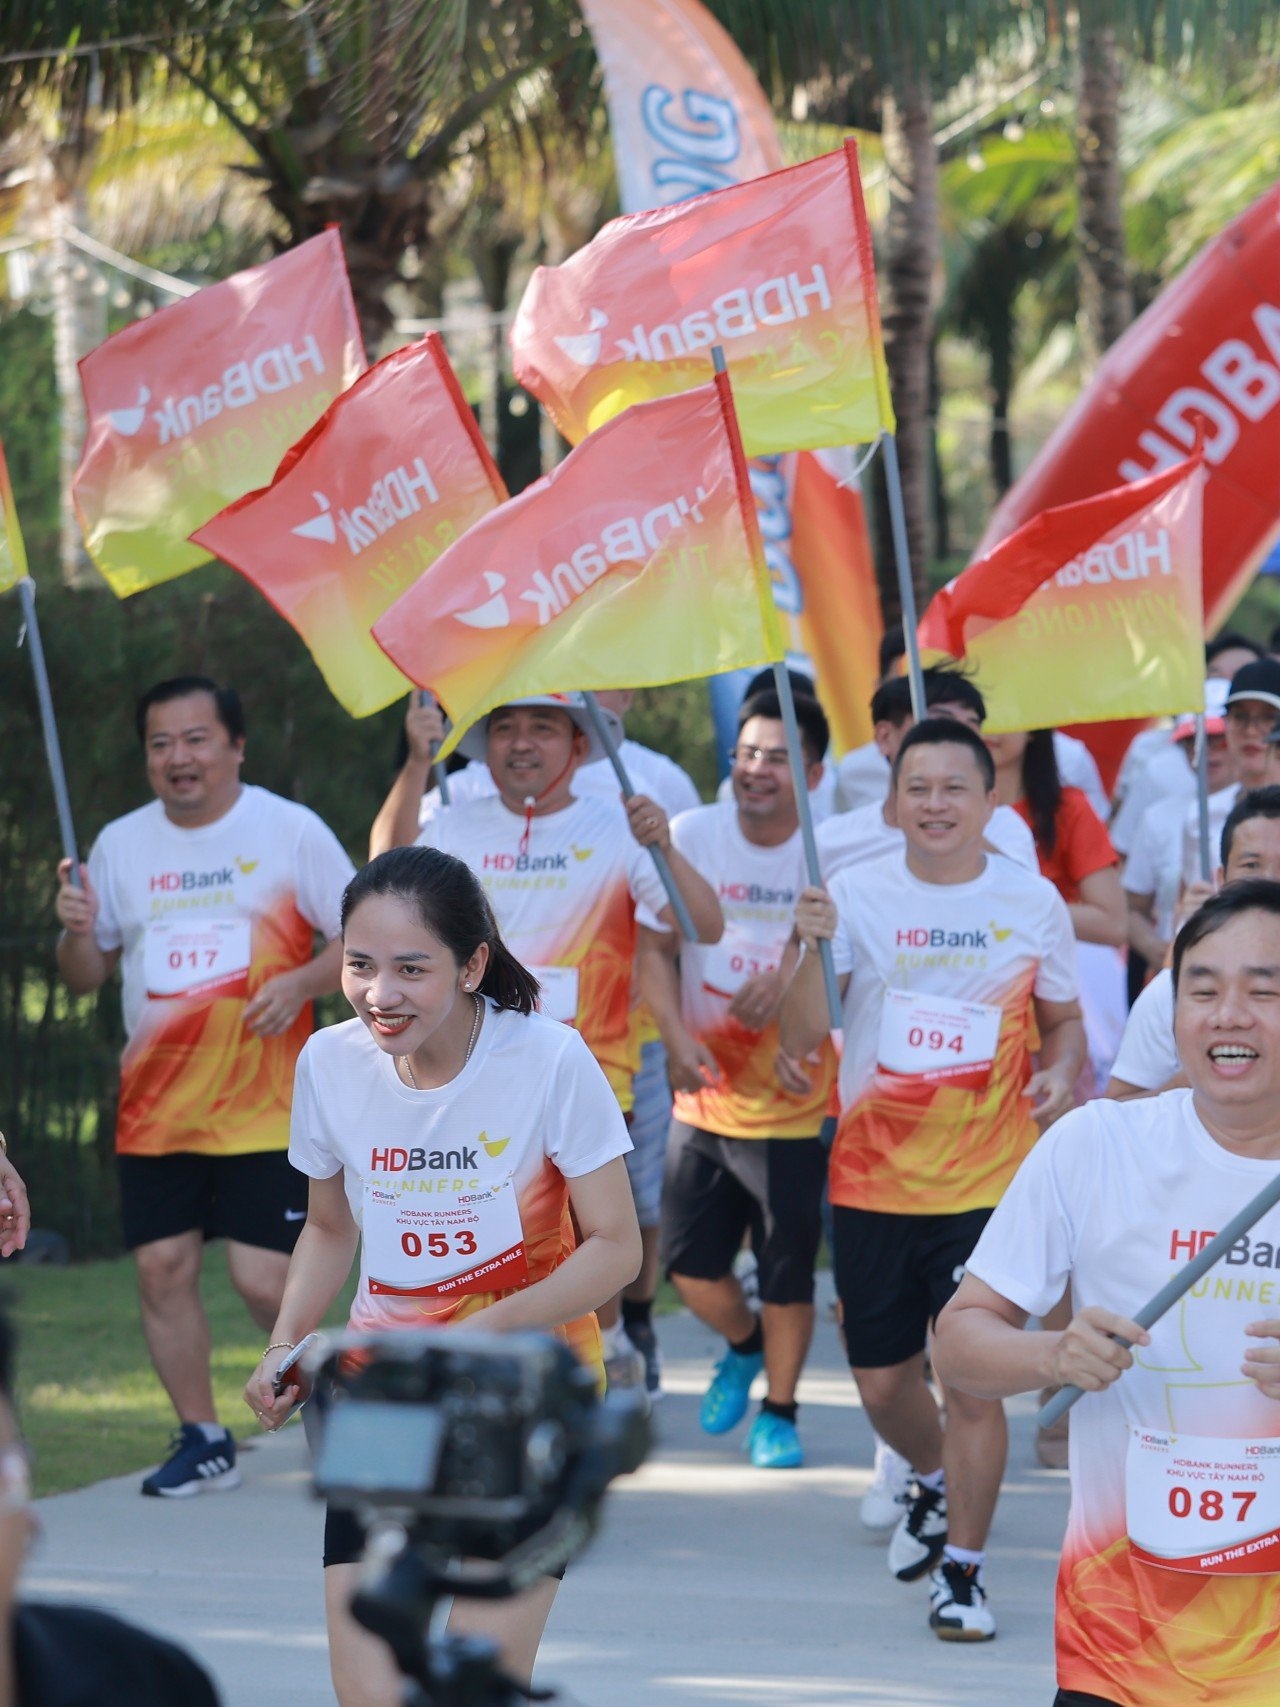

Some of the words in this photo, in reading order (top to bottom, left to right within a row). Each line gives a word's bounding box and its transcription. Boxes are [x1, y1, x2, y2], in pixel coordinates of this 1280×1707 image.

[483, 853, 568, 871] HDBank
[149, 868, 234, 891] HDBank
[896, 929, 987, 949] HDBank
[169, 950, 218, 969] 017
[908, 1027, 963, 1054] 094
[371, 1147, 478, 1172] HDBank
[458, 1191, 493, 1203] HDBank
[400, 1209, 433, 1217] HDBANK
[434, 1208, 472, 1217] RUNNERS
[401, 1230, 478, 1258] 053
[437, 1281, 456, 1293] RUN
[456, 1273, 474, 1285] THE
[474, 1261, 502, 1278] EXTRA
[501, 1248, 522, 1264] MILE
[1173, 1459, 1212, 1469] HDBANK
[1168, 1487, 1257, 1522] 087
[1200, 1553, 1223, 1568] RUN
[1224, 1547, 1245, 1561] THE
[1246, 1534, 1279, 1554] EXTRA
